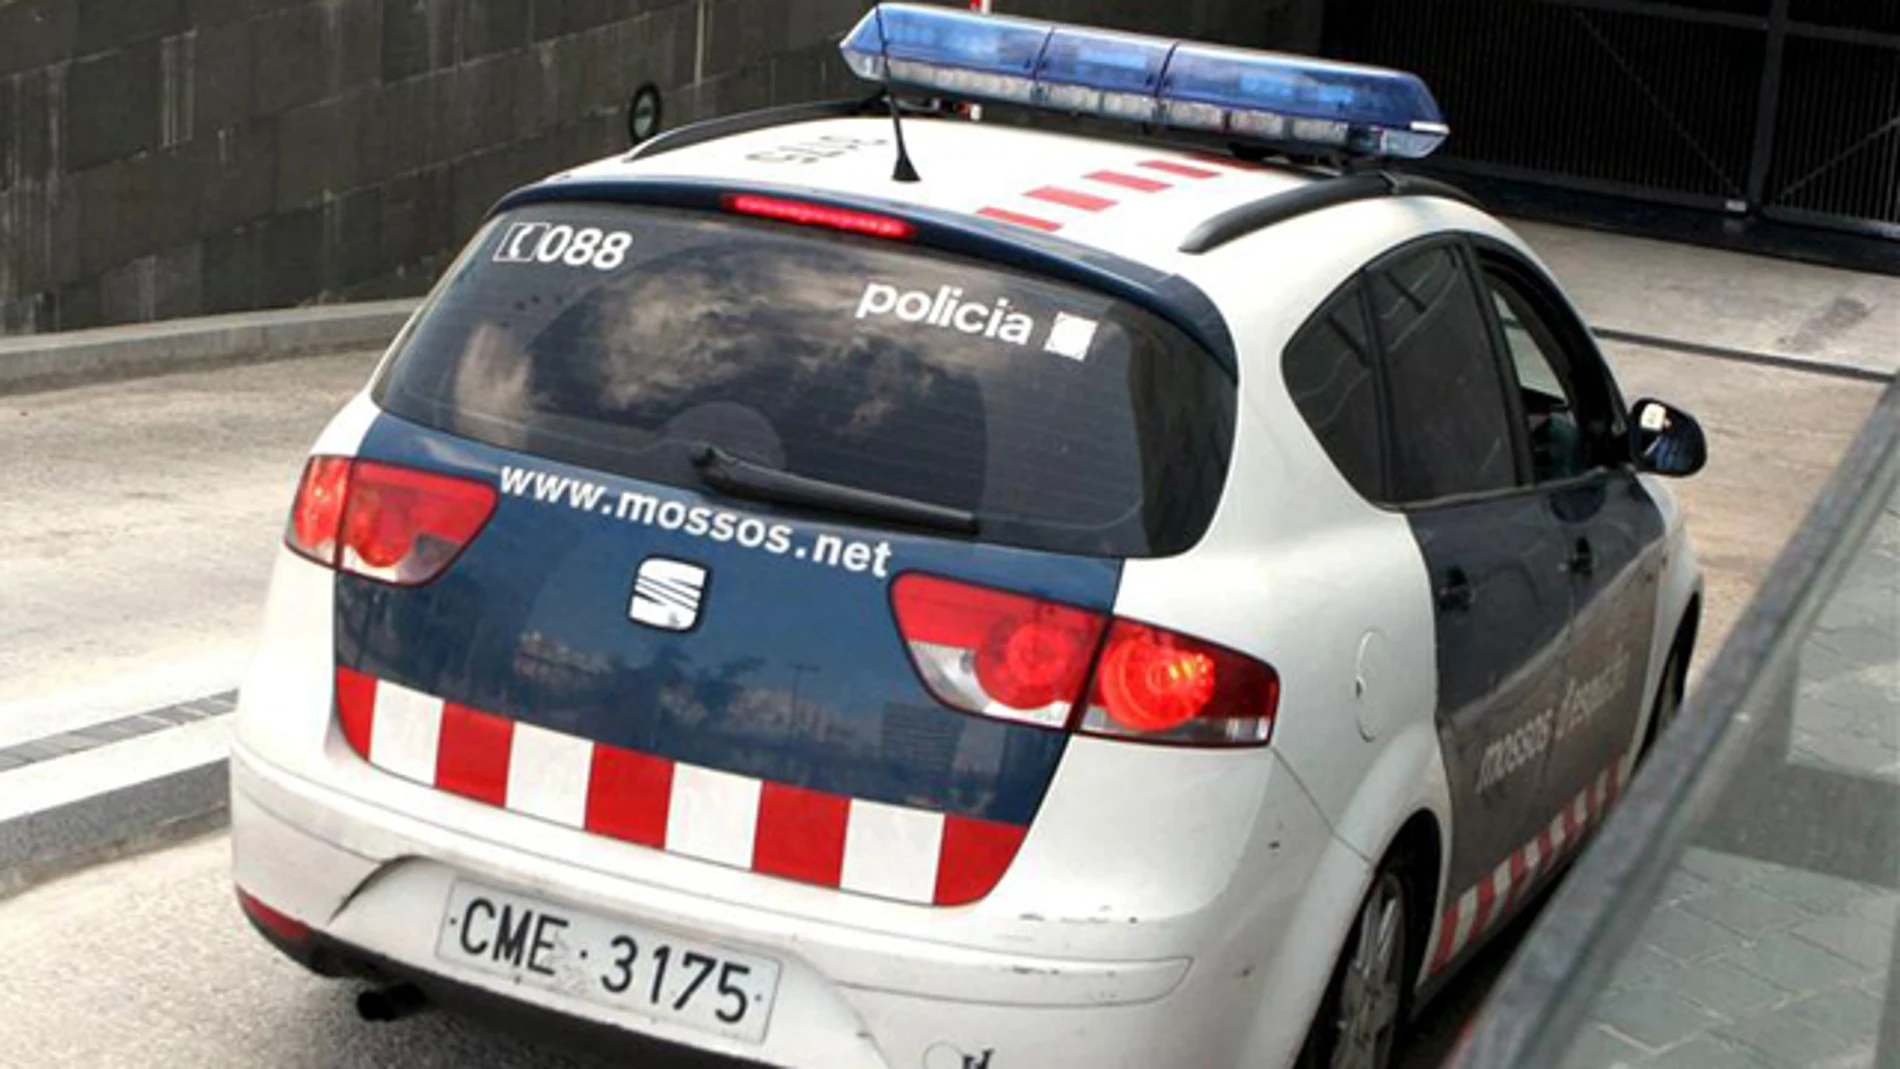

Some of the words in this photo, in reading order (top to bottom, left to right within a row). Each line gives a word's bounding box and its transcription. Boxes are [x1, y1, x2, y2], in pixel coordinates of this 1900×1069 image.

[537, 224, 633, 270] 088
[855, 282, 1033, 346] policia
[499, 465, 892, 578] www.mossos.net
[600, 934, 750, 1024] 3175
